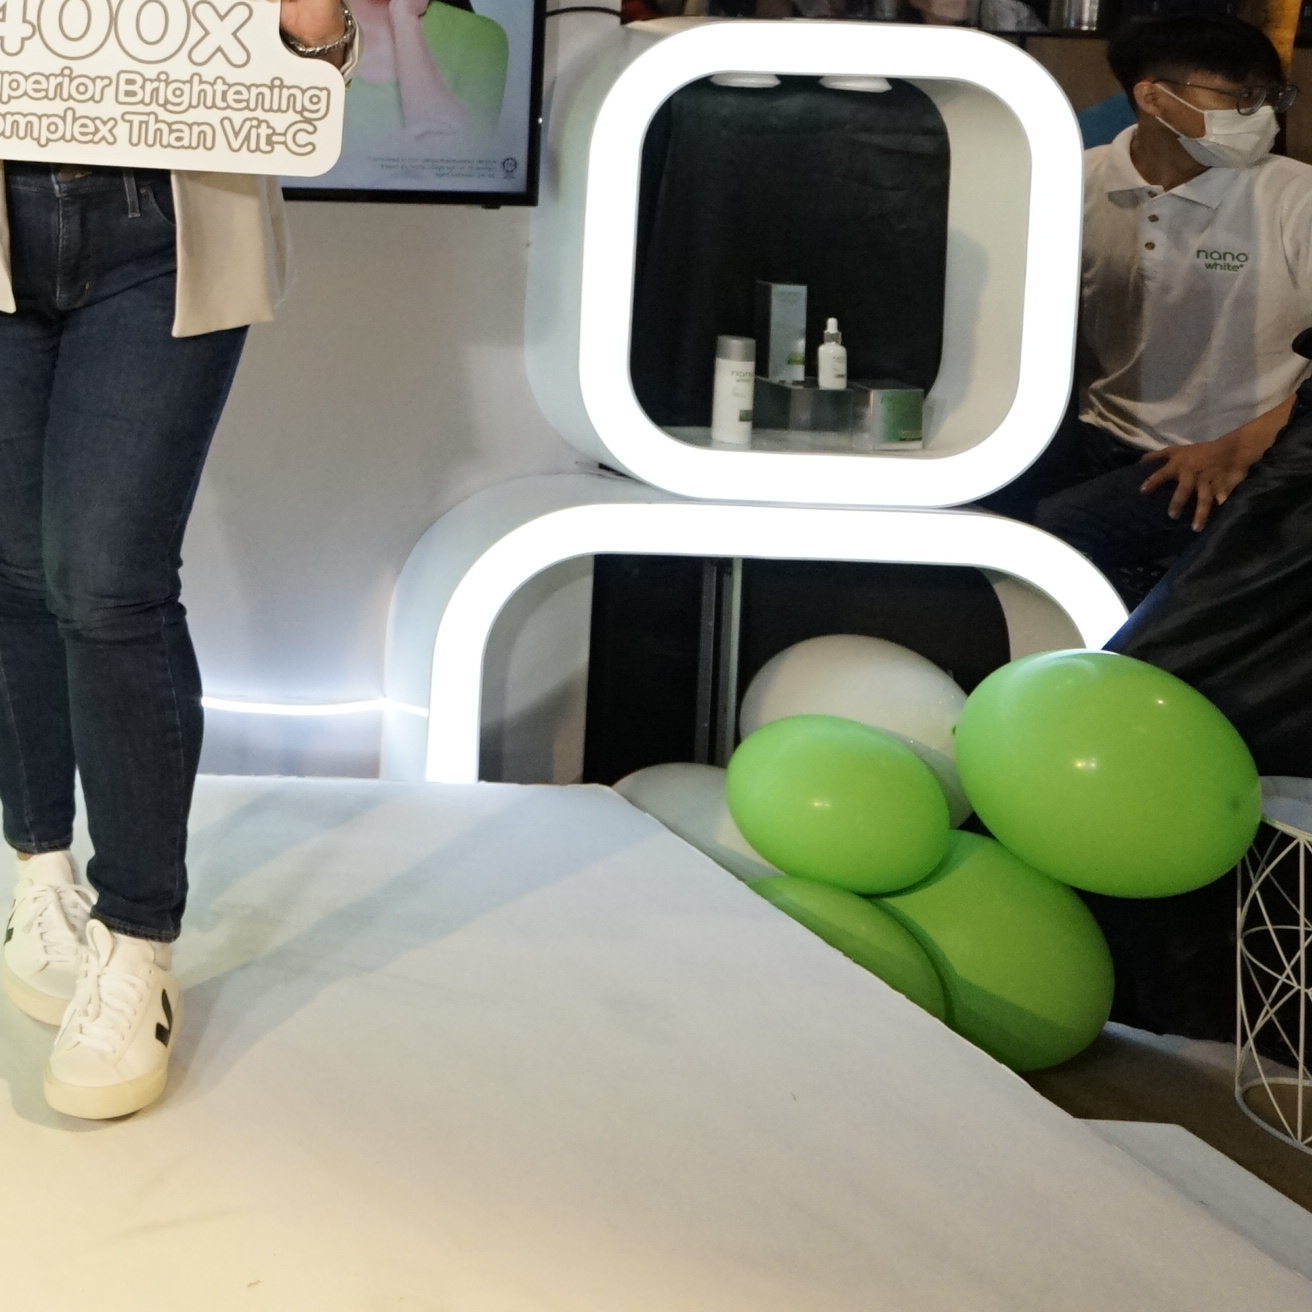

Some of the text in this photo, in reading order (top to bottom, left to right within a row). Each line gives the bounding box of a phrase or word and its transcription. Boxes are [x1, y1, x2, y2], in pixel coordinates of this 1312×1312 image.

[116, 70, 330, 118] Brightening
[122, 112, 215, 151] Than
[221, 118, 317, 156] Vit-C
[1197, 250, 1248, 262] nano
